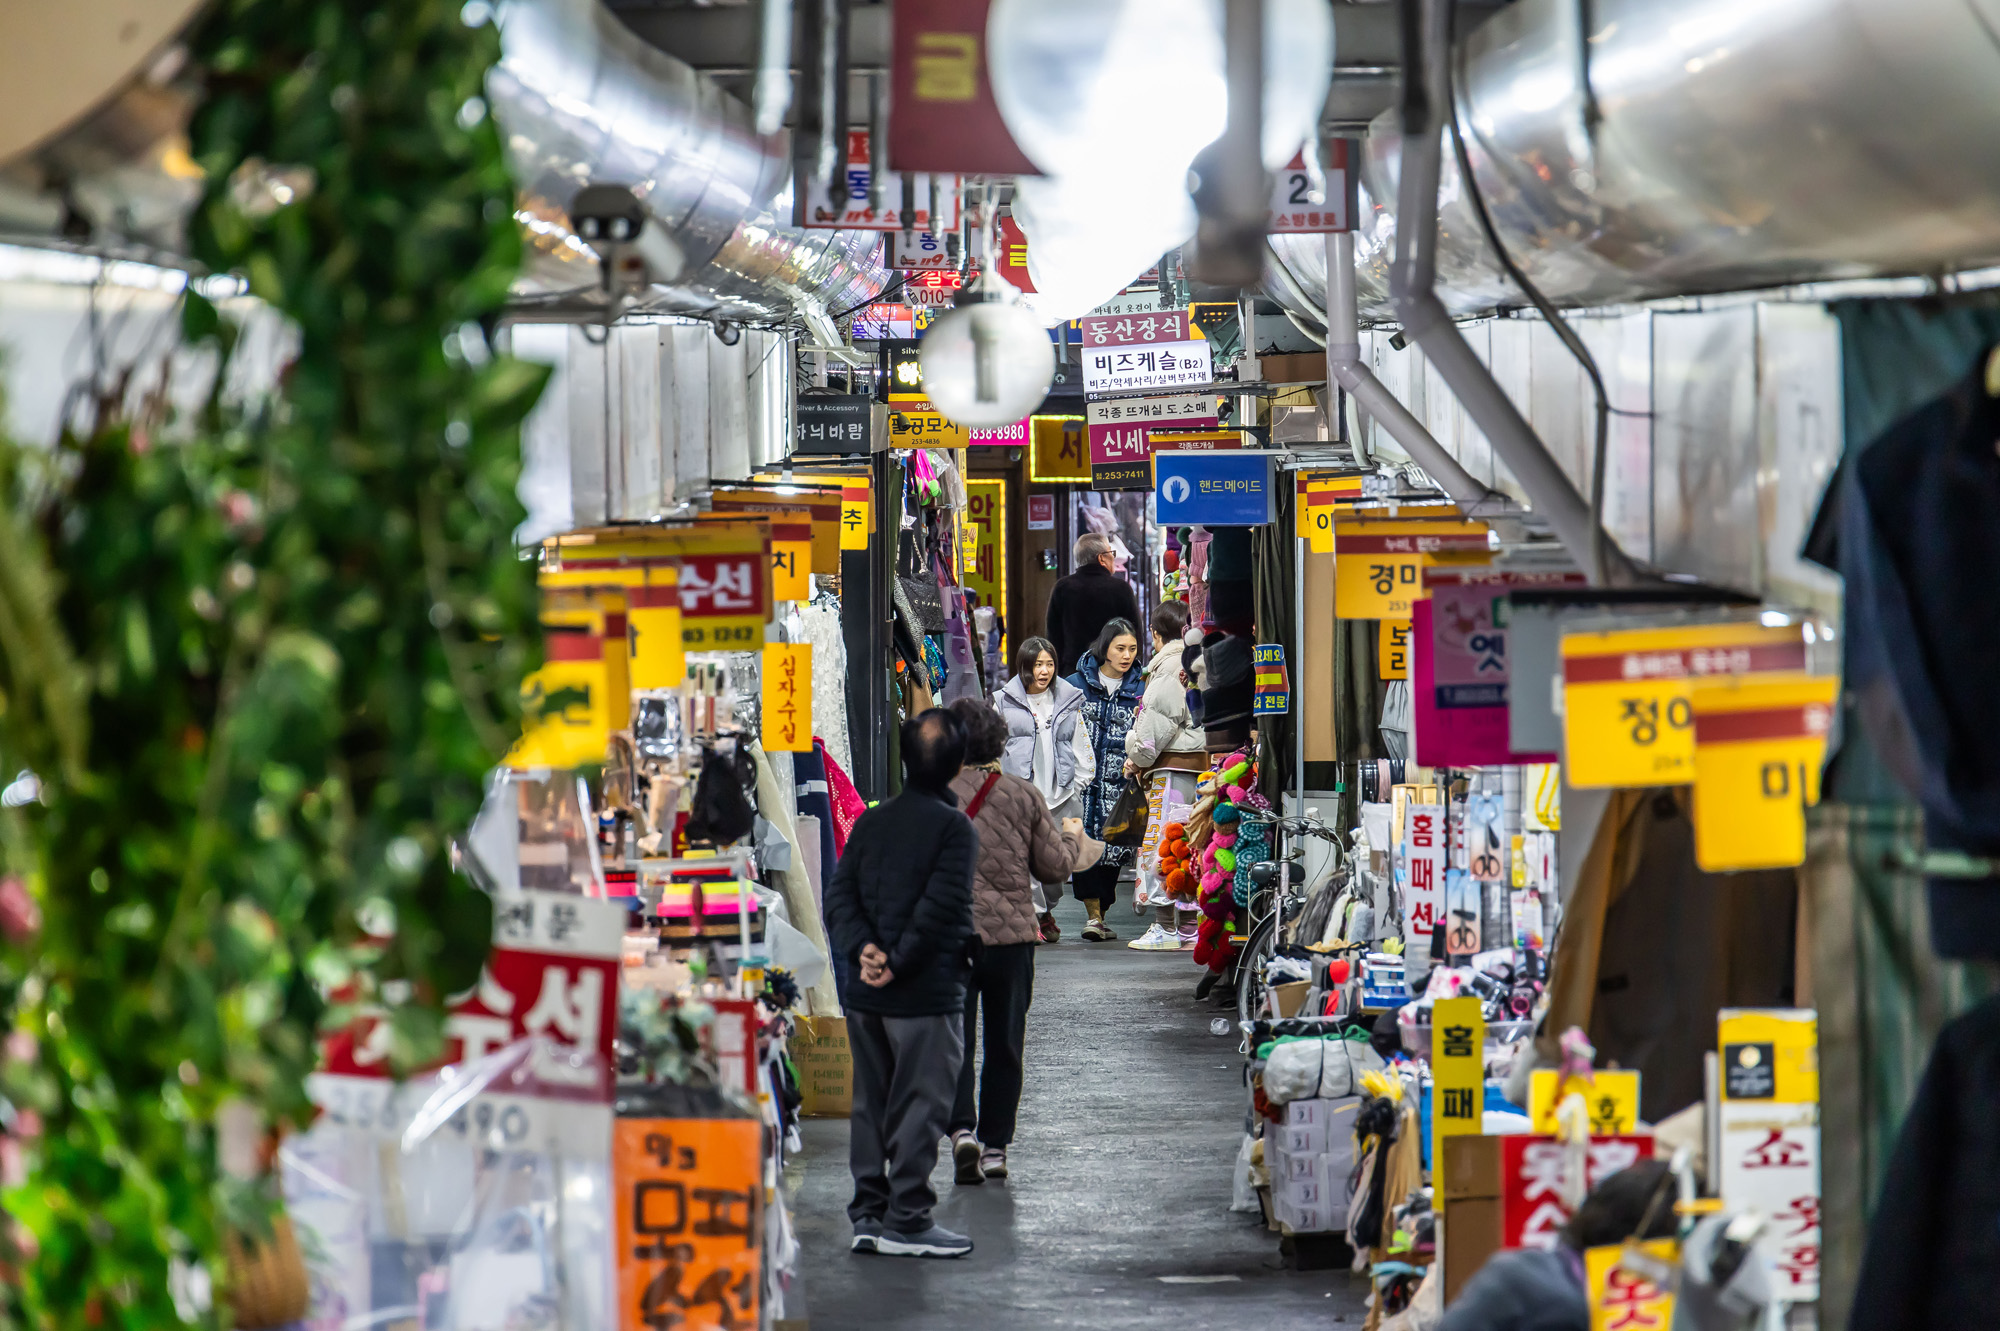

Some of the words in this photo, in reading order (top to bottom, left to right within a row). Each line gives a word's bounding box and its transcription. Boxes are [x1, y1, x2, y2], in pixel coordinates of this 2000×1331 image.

[1289, 174, 1309, 204] 2
[1089, 315, 1182, 345] 동산장식
[823, 404, 860, 413] Accessory
[1098, 406, 1122, 419] 각종
[1126, 404, 1163, 417] 뜨개실
[1178, 441, 1215, 450] 각종뜨개실
[1199, 479, 1263, 494] 핸드메이드
[679, 562, 754, 609] 수선
[1149, 776, 1167, 821] KENT
[1411, 813, 1434, 936] 홈패션
